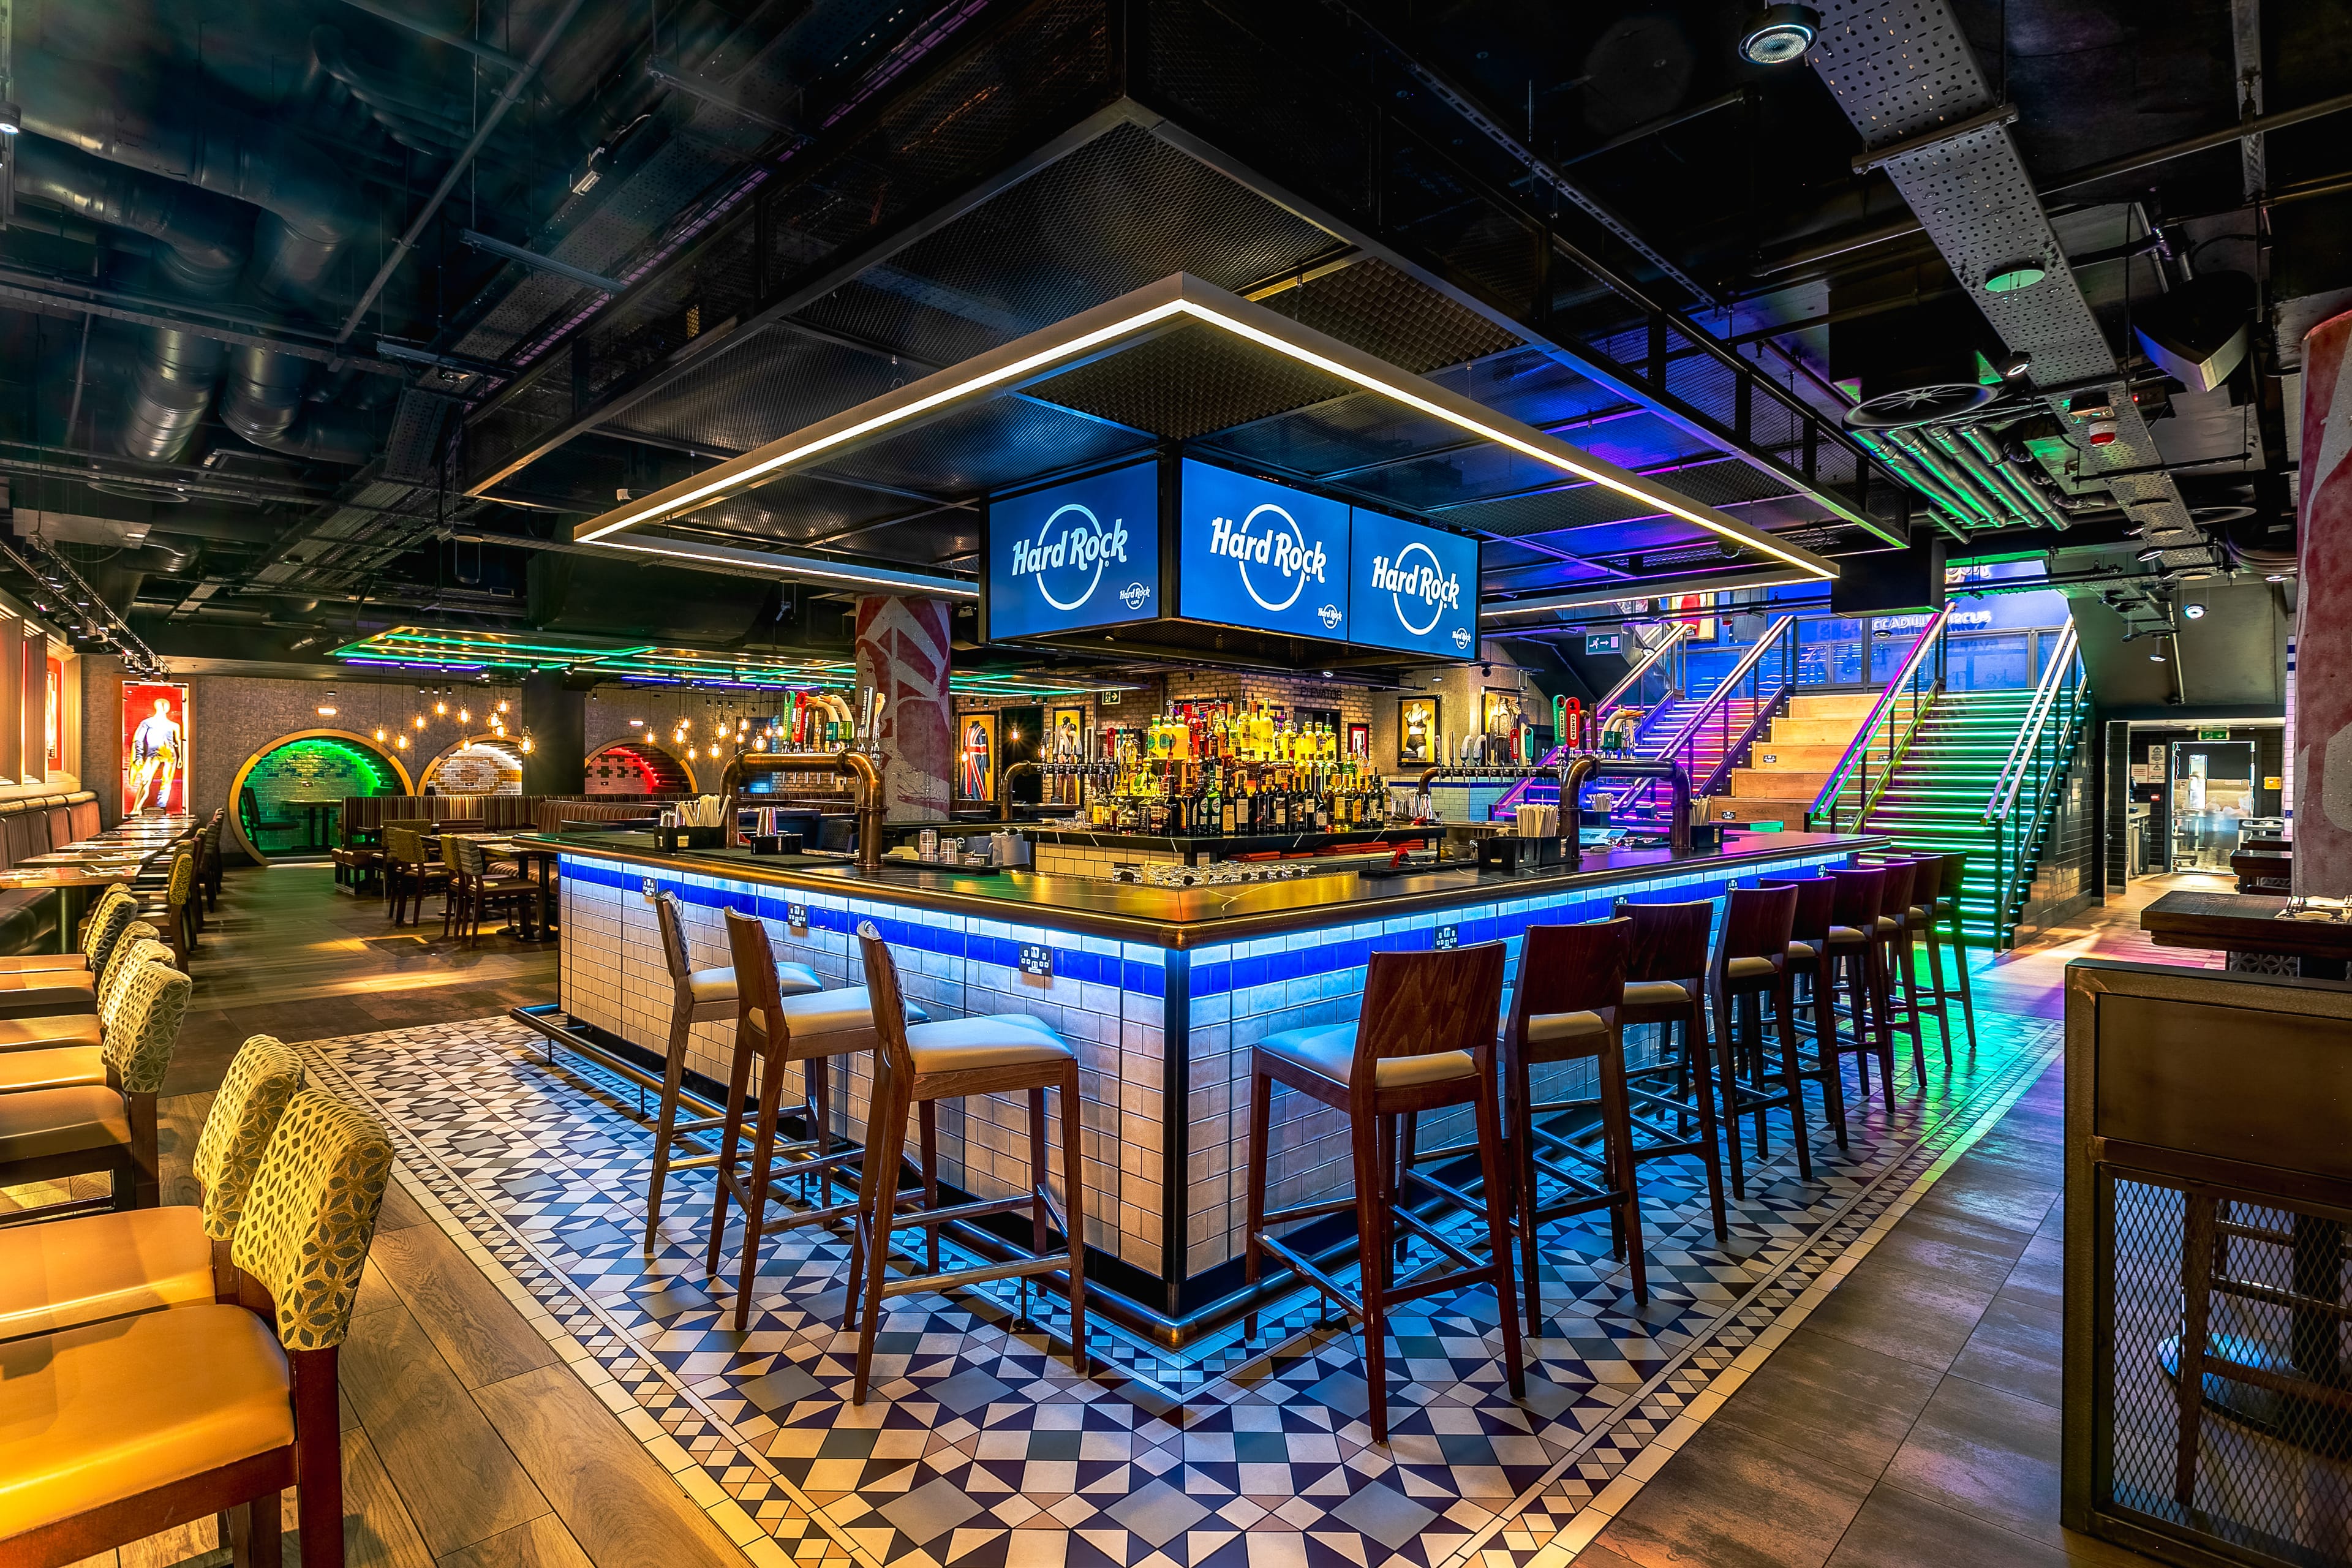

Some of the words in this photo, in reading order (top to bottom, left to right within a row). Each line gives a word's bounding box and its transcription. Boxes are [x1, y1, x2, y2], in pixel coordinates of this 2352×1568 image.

[1012, 530, 1068, 576] Hard
[1069, 518, 1128, 571] Rock
[1210, 516, 1274, 565] Hard
[1274, 532, 1327, 584] Rock
[1119, 588, 1135, 600] Hard
[1135, 586, 1150, 599] Rock
[1371, 556, 1420, 595] Hard
[1419, 567, 1460, 610] Rock
[1317, 607, 1331, 618] Hard
[1330, 609, 1342, 622] Rock
[1947, 611, 1992, 624] IRCUS
